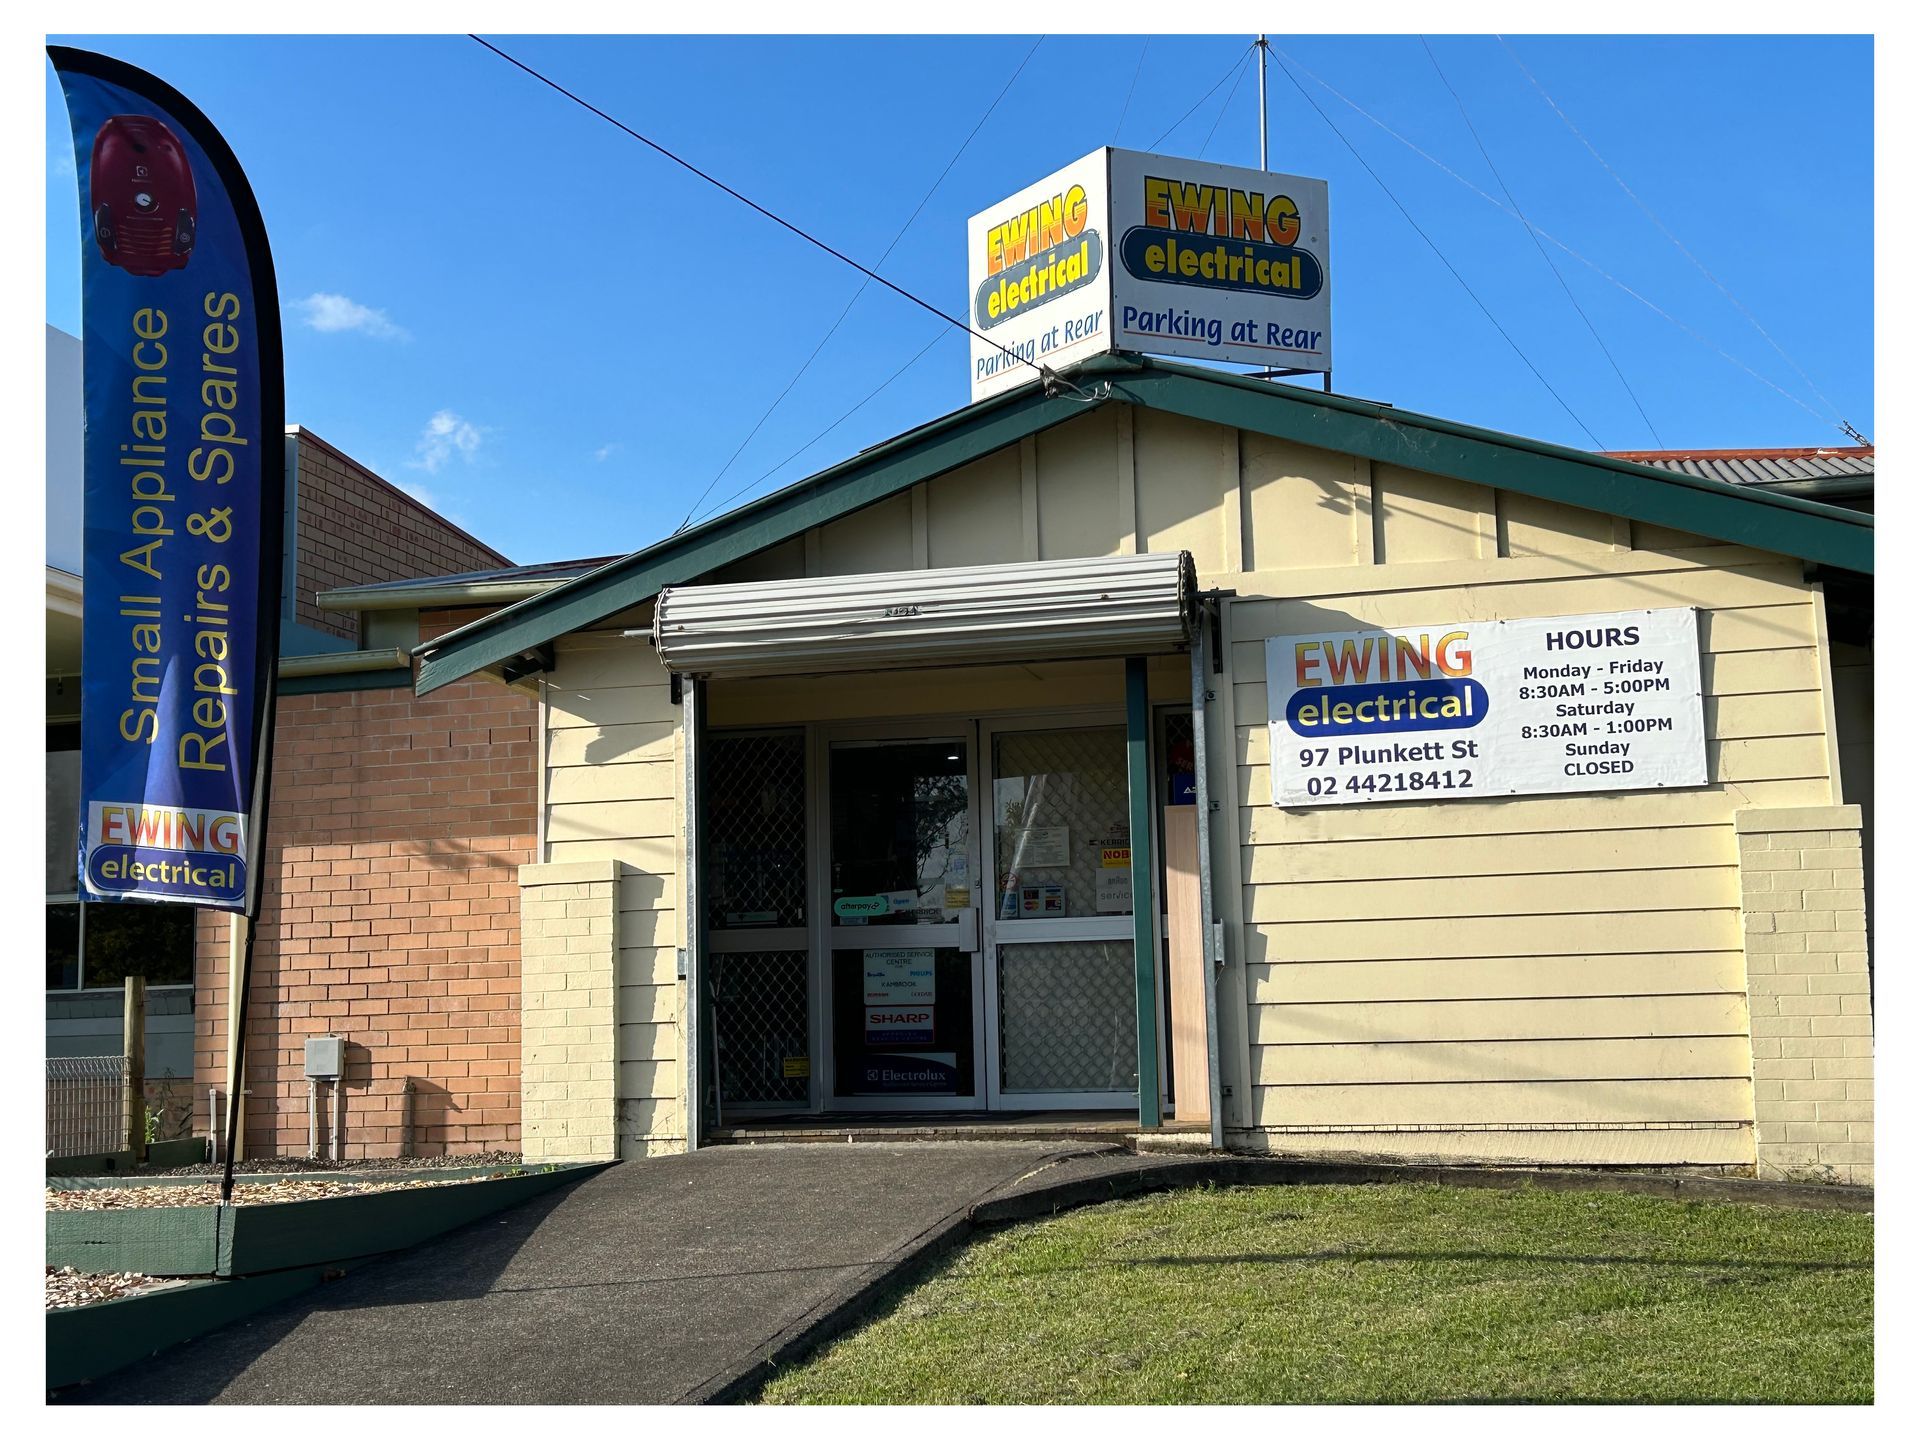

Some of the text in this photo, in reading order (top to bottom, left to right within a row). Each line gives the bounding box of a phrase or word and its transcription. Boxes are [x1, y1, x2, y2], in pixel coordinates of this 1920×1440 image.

[1144, 175, 1300, 248] EWING
[987, 184, 1088, 277] EWING
[1145, 238, 1301, 289] electrical
[987, 240, 1089, 319] electrical
[1123, 306, 1322, 350] Parking at Rear
[976, 309, 1103, 380] Parking at Rear
[120, 308, 175, 744] Small Appliance
[179, 292, 247, 771] Repairs & Spares
[1546, 626, 1640, 651] HOURS
[1295, 631, 1472, 687] EWING
[1523, 664, 1591, 680] Monday
[1609, 659, 1664, 675] Friday
[1519, 683, 1585, 700] 8:30AM
[1603, 678, 1670, 695] 5:00PM
[1298, 686, 1472, 726] electrical
[1556, 701, 1635, 717] Saturday
[1521, 722, 1587, 739] 8:30AM
[1606, 717, 1673, 734] 1:00PM
[1299, 740, 1478, 768] 97 Plunkett St
[1565, 741, 1630, 757] Sunday
[1564, 760, 1634, 776] CLOSED
[1307, 769, 1473, 796] 02 44218412
[101, 806, 238, 854] EWING
[1104, 850, 1131, 859] NOB
[101, 854, 235, 889] electrical
[840, 903, 872, 911] afterpay
[870, 1014, 929, 1023] SHARP
[882, 1069, 946, 1081] Electrolux
